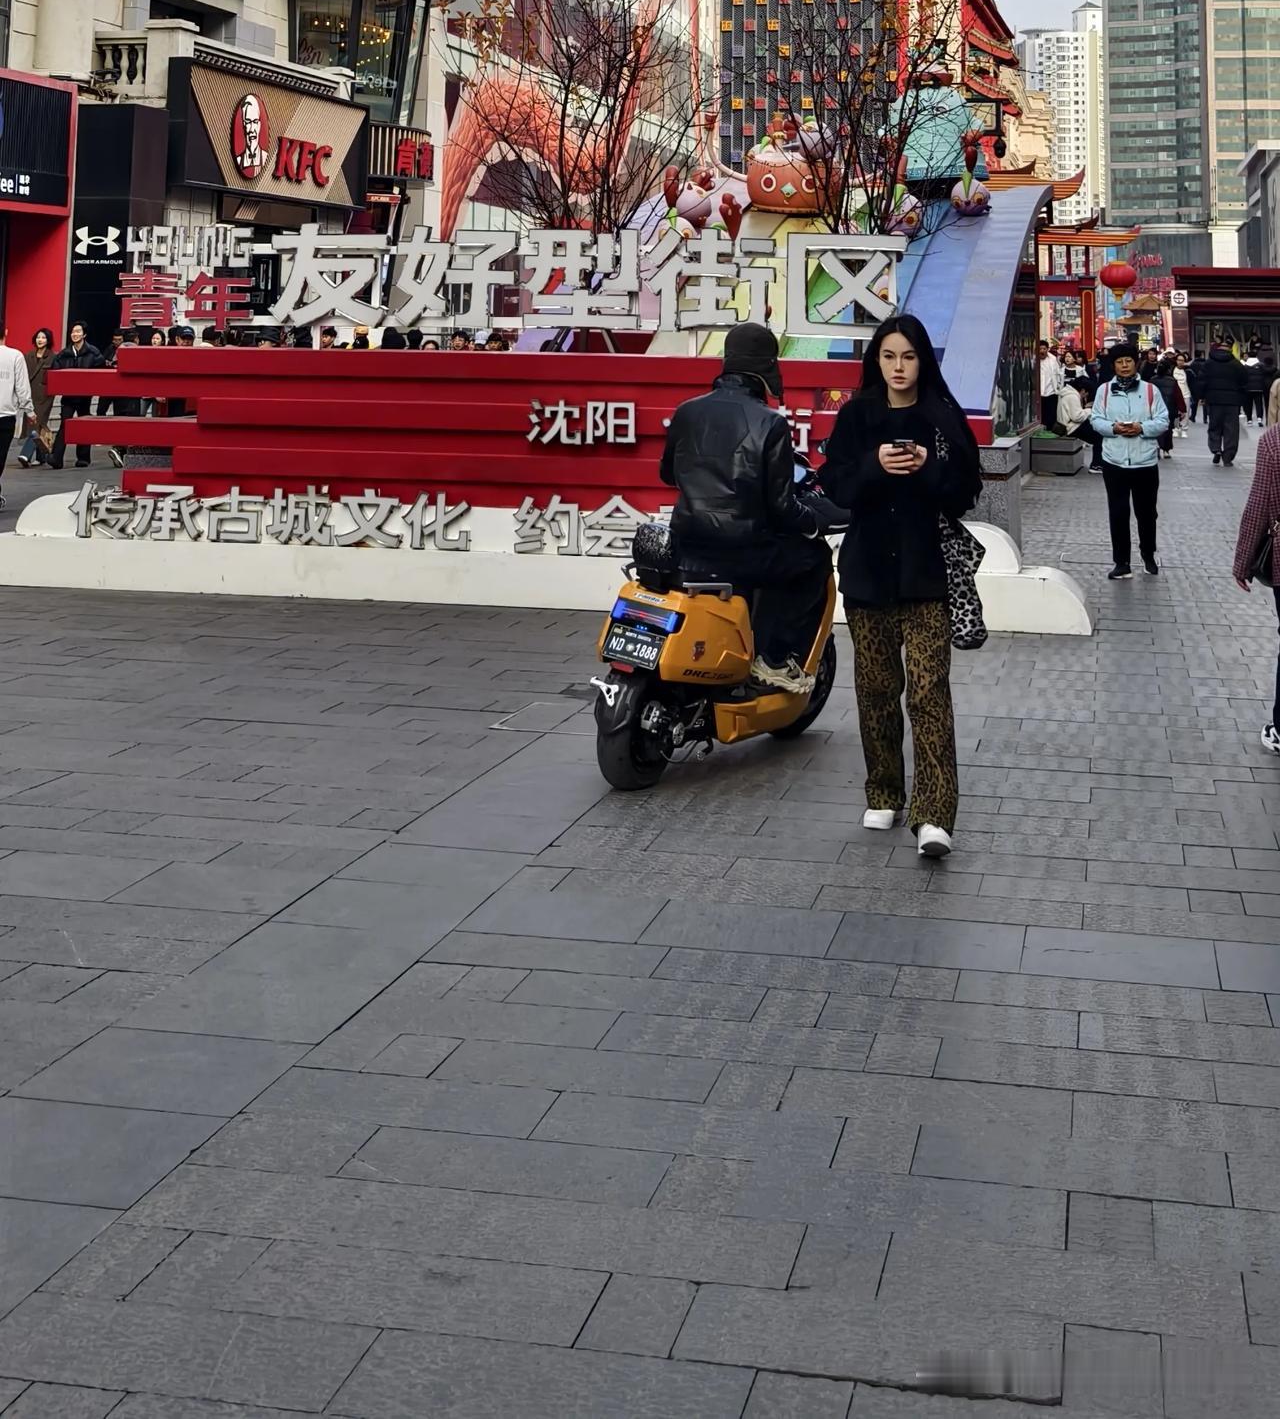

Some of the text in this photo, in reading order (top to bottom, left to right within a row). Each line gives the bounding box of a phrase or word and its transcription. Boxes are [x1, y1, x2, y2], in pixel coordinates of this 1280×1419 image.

[273, 136, 333, 187] KFC
[126, 225, 254, 274] YOUNG
[115, 269, 255, 332] 青年
[271, 223, 908, 337] 友好型街区
[527, 399, 638, 446] 沈阳
[69, 479, 675, 558] 传承古城文化 约会
[609, 635, 626, 651] ND
[632, 643, 658, 661] 1888
